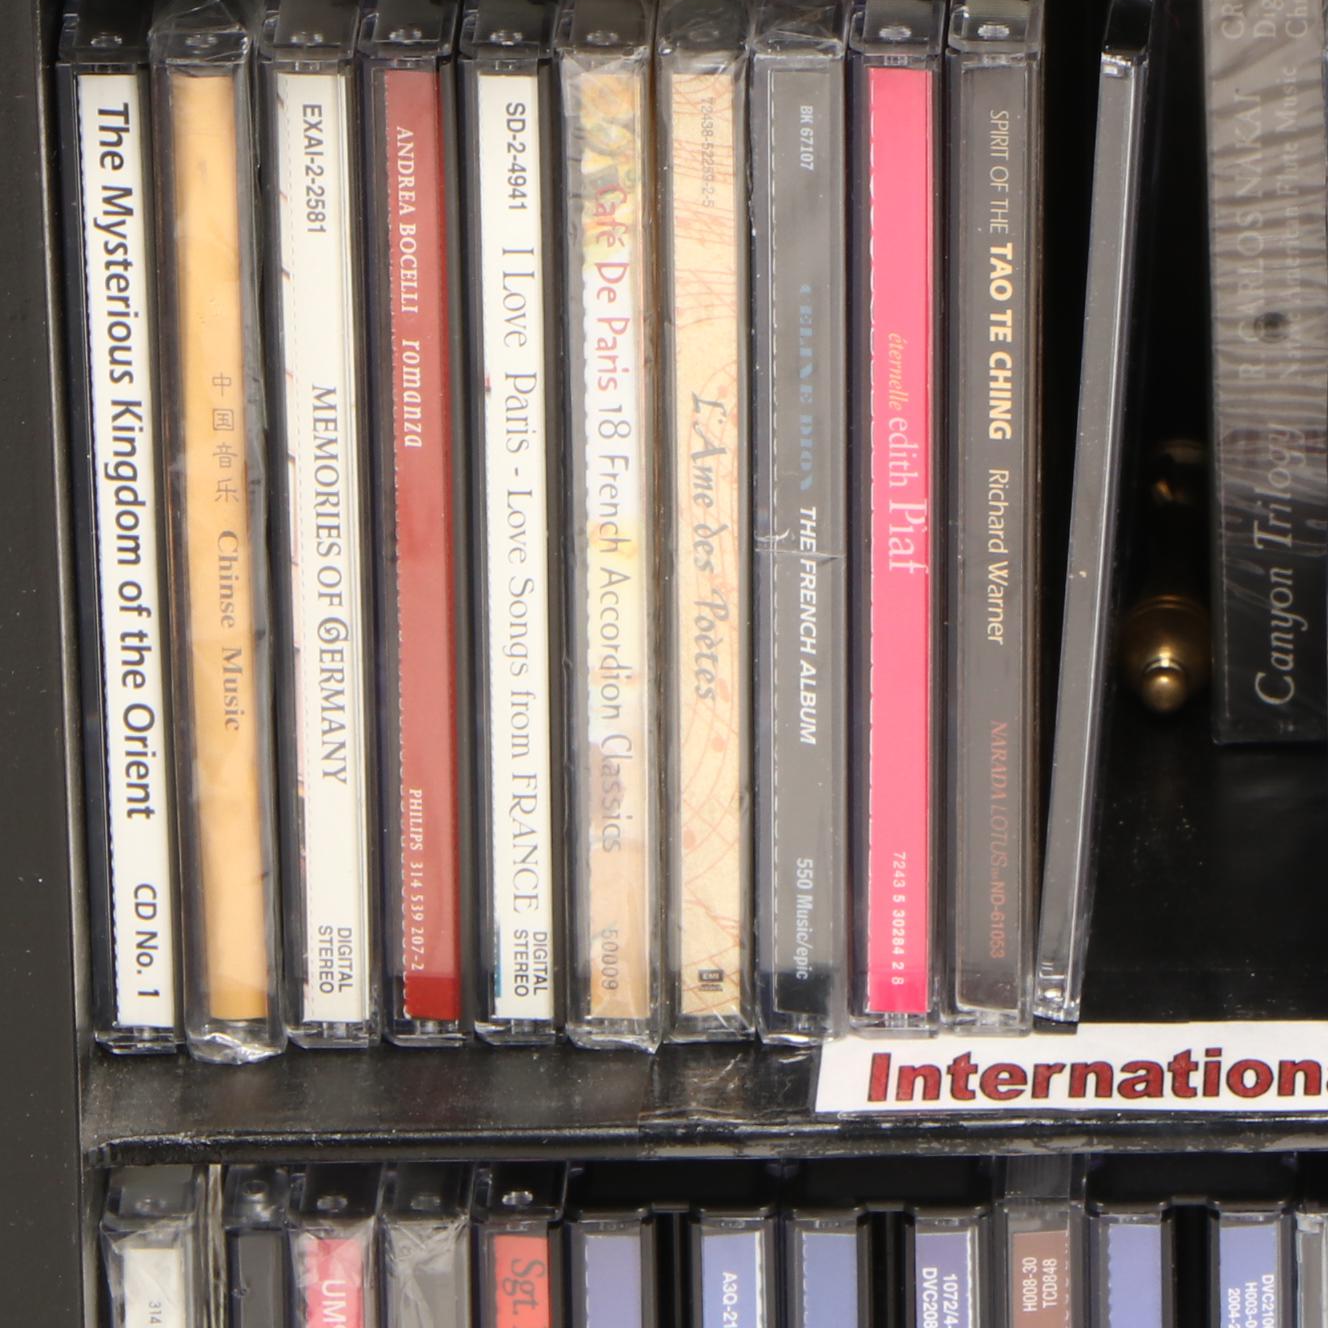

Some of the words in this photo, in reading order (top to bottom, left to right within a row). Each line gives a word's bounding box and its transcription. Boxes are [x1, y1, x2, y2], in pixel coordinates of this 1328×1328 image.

[98, 104, 131, 171] The
[302, 104, 326, 234] EXAI-2-2581
[396, 126, 418, 215] ANDREA
[505, 102, 528, 211] SD-2-4941
[95, 185, 142, 383] Mysterious
[399, 222, 419, 313] BOCELLI
[989, 243, 1013, 301] TAO
[989, 310, 1012, 342] TE
[401, 339, 423, 447] romanza
[988, 352, 1013, 440] CHING
[107, 400, 146, 565] Kingdom
[311, 385, 343, 557] MEMORIES
[887, 417, 918, 487] edith
[888, 498, 928, 574] Piaf
[987, 468, 1009, 552] Richard
[118, 581, 151, 617] of
[317, 566, 343, 607] OF
[986, 562, 1006, 645] Warner
[120, 630, 151, 689] the
[221, 647, 245, 730] Music
[317, 616, 349, 784] GERMANY
[123, 703, 156, 819] Orient
[513, 929, 531, 997] STEREO
[531, 931, 548, 995] DIGITAL
